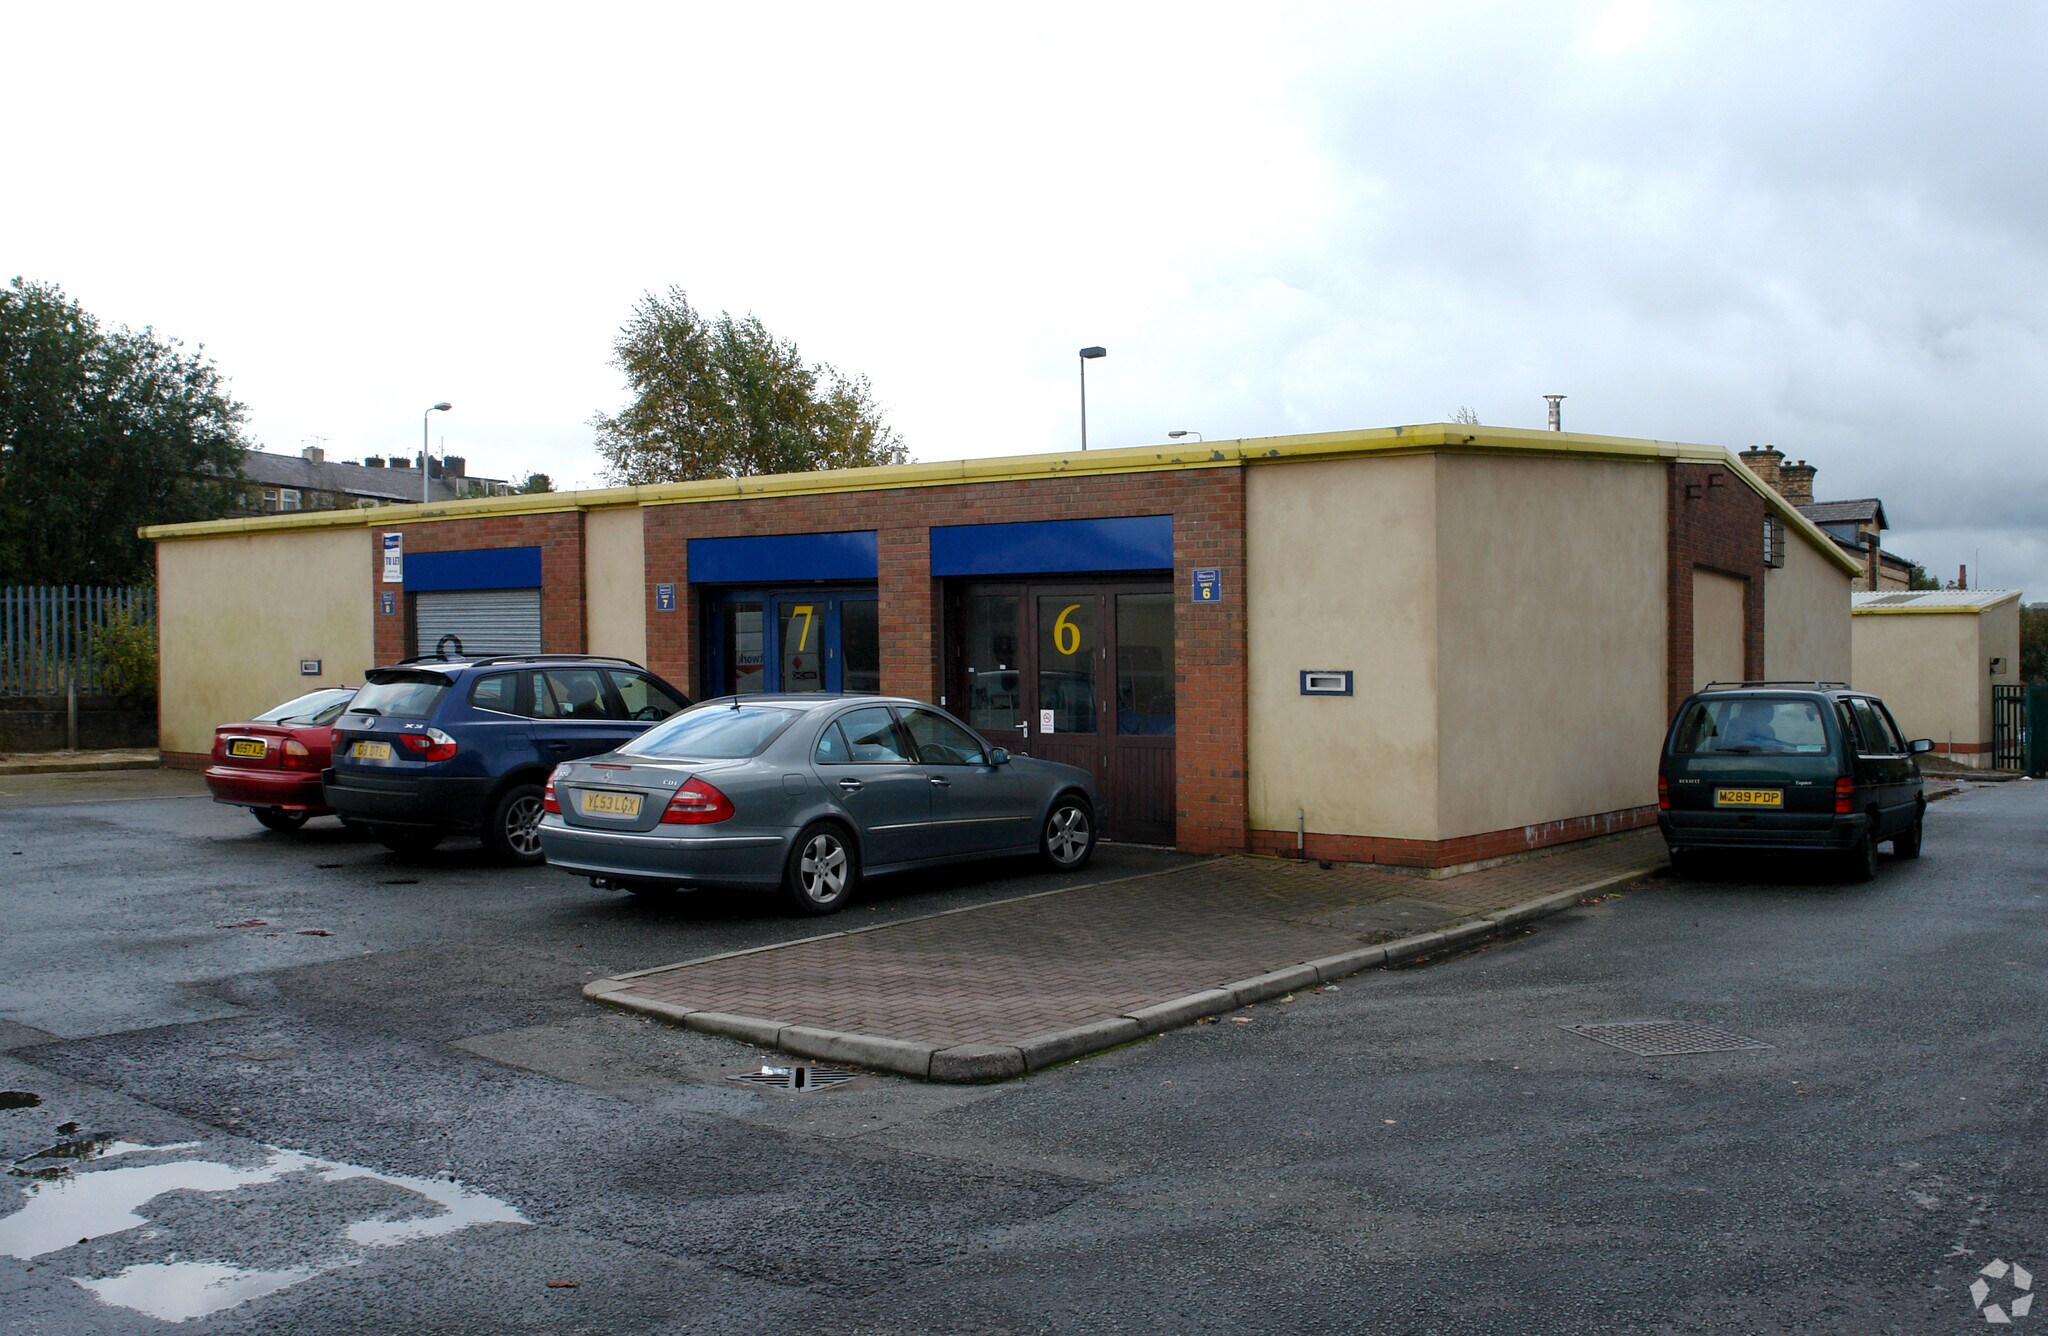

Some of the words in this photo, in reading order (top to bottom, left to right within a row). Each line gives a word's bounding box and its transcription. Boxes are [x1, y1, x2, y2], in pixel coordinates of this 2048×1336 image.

[385, 556, 392, 566] TO
[392, 556, 400, 566] LET
[1202, 588, 1210, 599] 6
[662, 599, 668, 608] 7
[792, 605, 814, 652] 7
[1053, 603, 1081, 655] 6
[1719, 791, 1751, 802] M289
[1754, 792, 1779, 803] PDP
[588, 794, 613, 809] YL53
[614, 796, 636, 813] LGX
